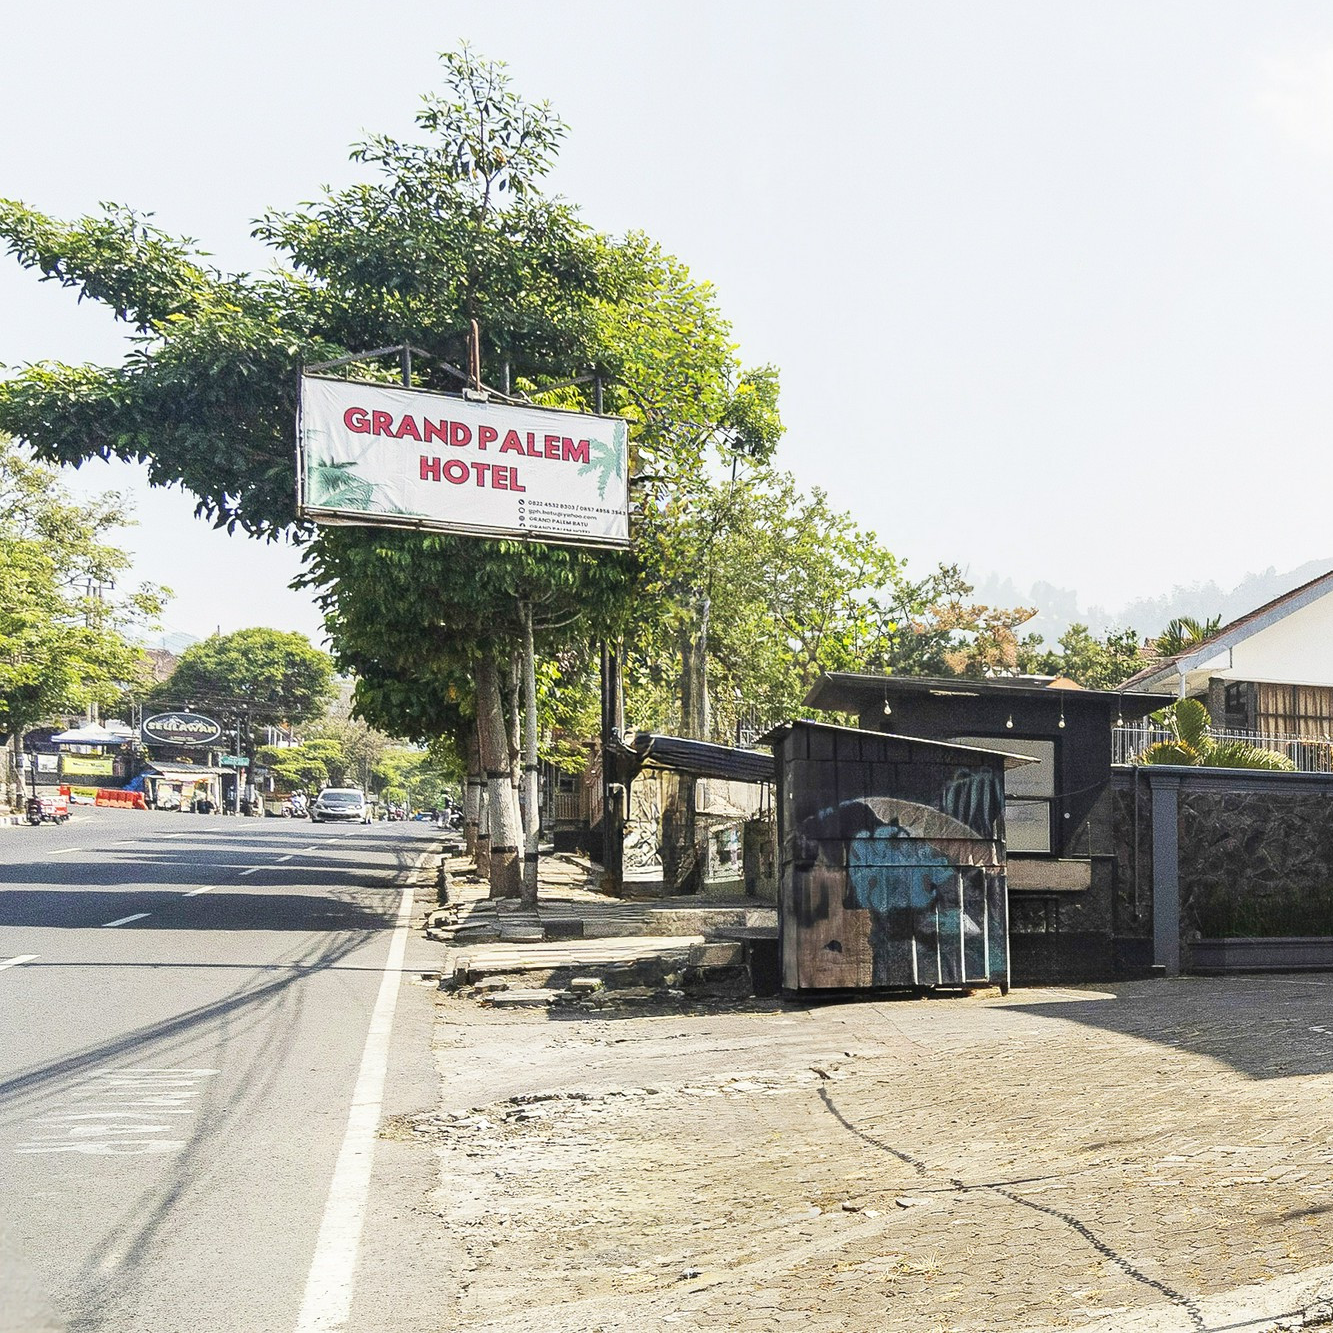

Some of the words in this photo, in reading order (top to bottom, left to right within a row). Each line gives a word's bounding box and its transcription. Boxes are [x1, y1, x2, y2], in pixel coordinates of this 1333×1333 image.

[343, 406, 473, 448] GRAND
[477, 424, 592, 465] PALEM
[419, 454, 527, 493] HOTEL
